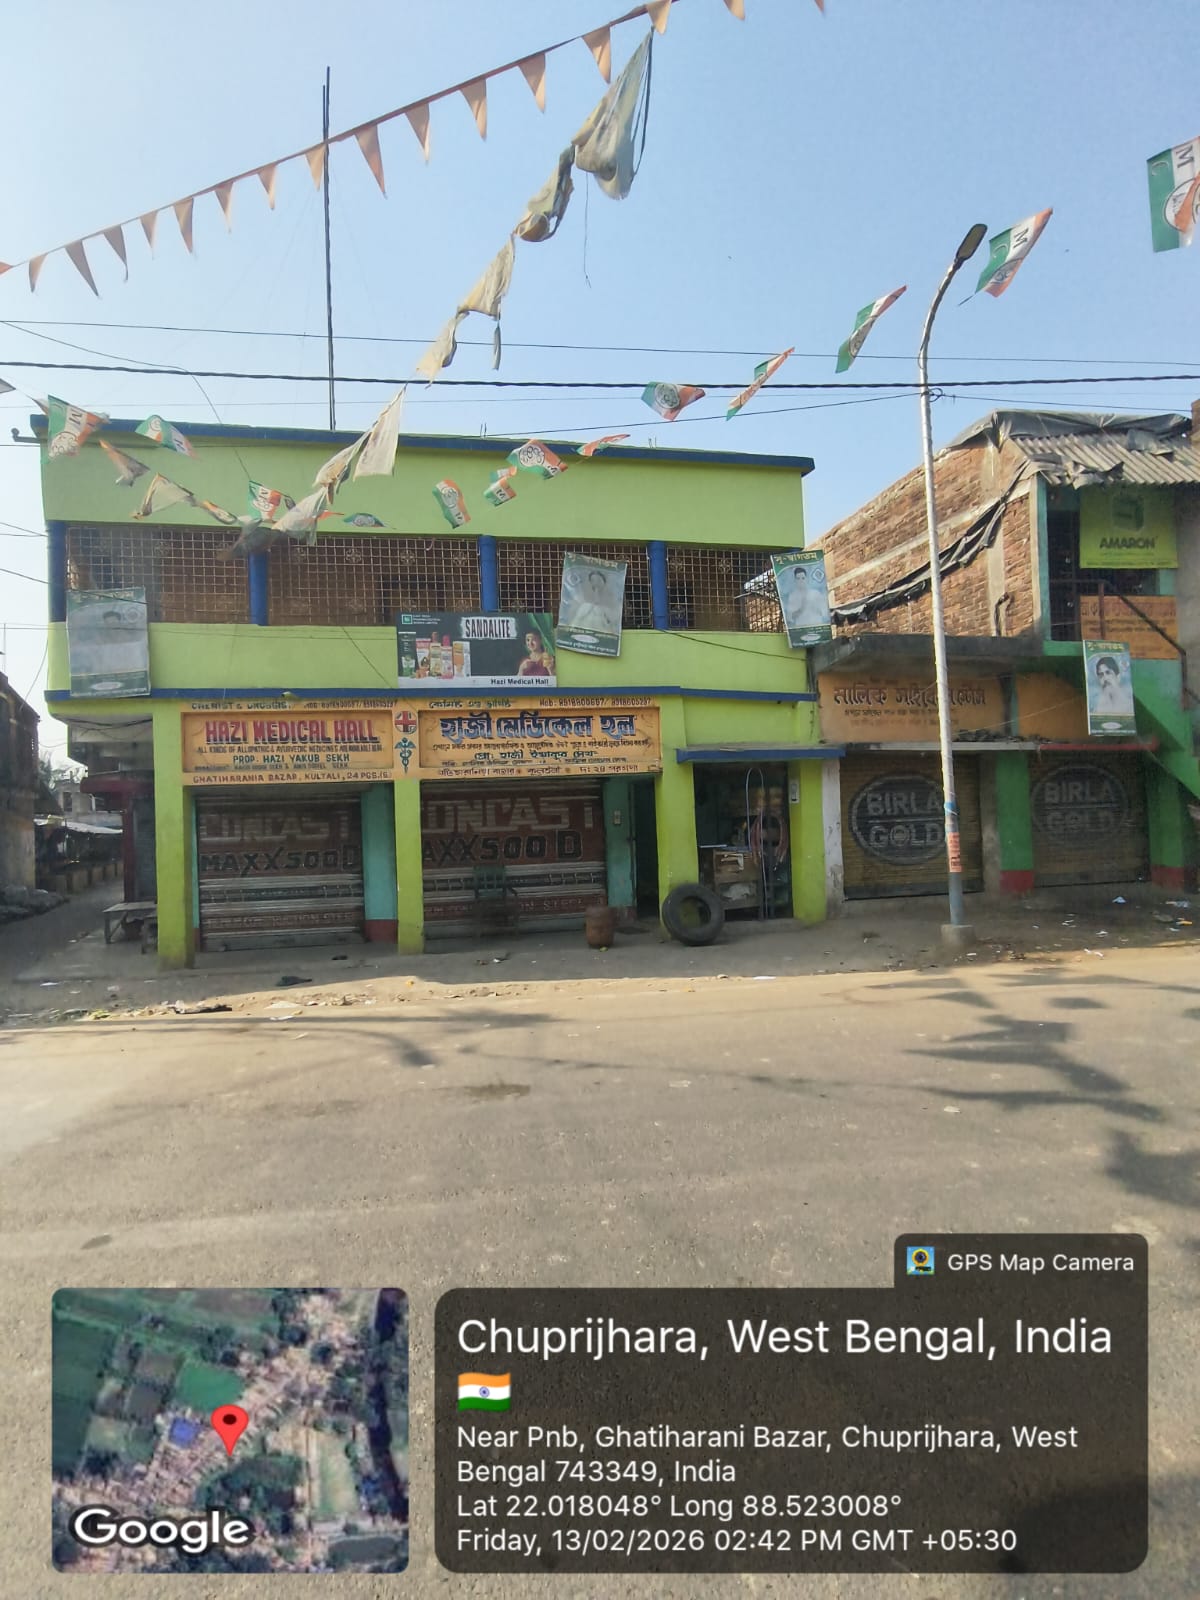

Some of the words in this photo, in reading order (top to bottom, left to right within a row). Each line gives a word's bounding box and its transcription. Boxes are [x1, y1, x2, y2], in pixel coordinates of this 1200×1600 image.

[1100, 536, 1156, 550] AMARON
[465, 617, 511, 639] SANDALITE
[491, 677, 506, 686] Hazi
[508, 677, 534, 686] Medical
[536, 677, 550, 686] Hall
[205, 719, 247, 744] HAZI
[252, 719, 331, 744] MEDICAL
[333, 719, 381, 744] HALL
[439, 711, 494, 745] হাজী
[496, 710, 594, 740] মেডিকেল
[600, 714, 637, 741] হল
[263, 754, 285, 764] HAZI
[289, 753, 320, 763] YAKUB
[326, 753, 350, 762] SEKH
[347, 771, 359, 780] 24
[866, 789, 943, 816] BIRLA
[1044, 780, 1117, 804] BIRLA
[477, 835, 549, 861] 500
[868, 823, 945, 849] GOLD
